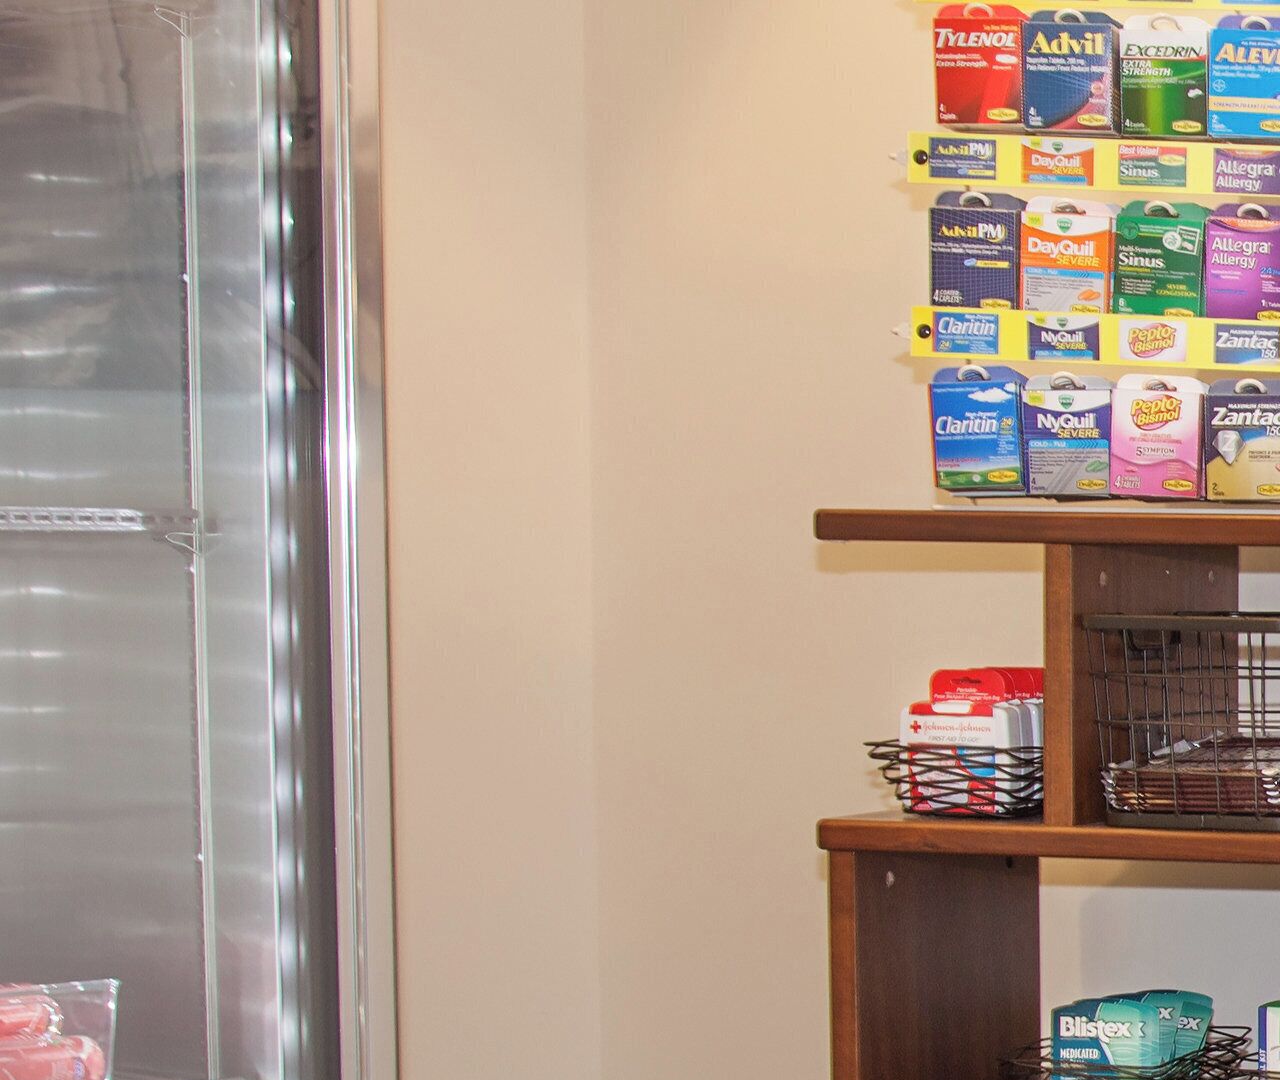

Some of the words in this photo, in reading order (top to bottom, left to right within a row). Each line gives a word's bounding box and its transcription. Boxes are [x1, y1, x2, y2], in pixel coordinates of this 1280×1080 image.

[935, 28, 1016, 48] TYLENOL
[1028, 31, 1105, 55] Advil
[1124, 44, 1202, 58] EXCEDRIN
[1122, 67, 1171, 76] STRENGTH
[1123, 60, 1152, 68] EXTRA
[937, 146, 968, 155] Advil
[968, 142, 990, 156] PM
[1119, 145, 1136, 153] Best
[1031, 154, 1081, 169] DayQuil
[1216, 160, 1273, 177] Allegra
[1052, 167, 1085, 175] SEVERE
[1120, 165, 1160, 178] Sinus
[1216, 176, 1261, 192] Allergy
[939, 226, 978, 238] Advil
[978, 224, 1002, 239] PM
[1027, 237, 1094, 258] DayQuil
[1212, 237, 1270, 256] Allegra
[1056, 255, 1100, 266] SEVERE
[1118, 252, 1164, 268] Sinus
[1211, 253, 1256, 270] Allergy
[933, 290, 939, 302] 4
[938, 316, 994, 336] Claritin
[1128, 325, 1176, 343] Pepto-
[1040, 330, 1083, 347] NyQuil
[1055, 342, 1087, 350] SEVERE
[1134, 337, 1174, 353] Bismol
[1216, 332, 1278, 349] Zantac
[1260, 349, 1276, 358] 150
[1131, 397, 1182, 416] Pepto-
[935, 416, 997, 434] Claritin
[1037, 413, 1096, 433] NyQuil
[1136, 410, 1179, 427] Bismol
[1057, 428, 1100, 438] SEVERE
[1115, 476, 1121, 488] 4
[1059, 1016, 1132, 1043] Blistex
[1060, 1048, 1098, 1059] MEDICATED
